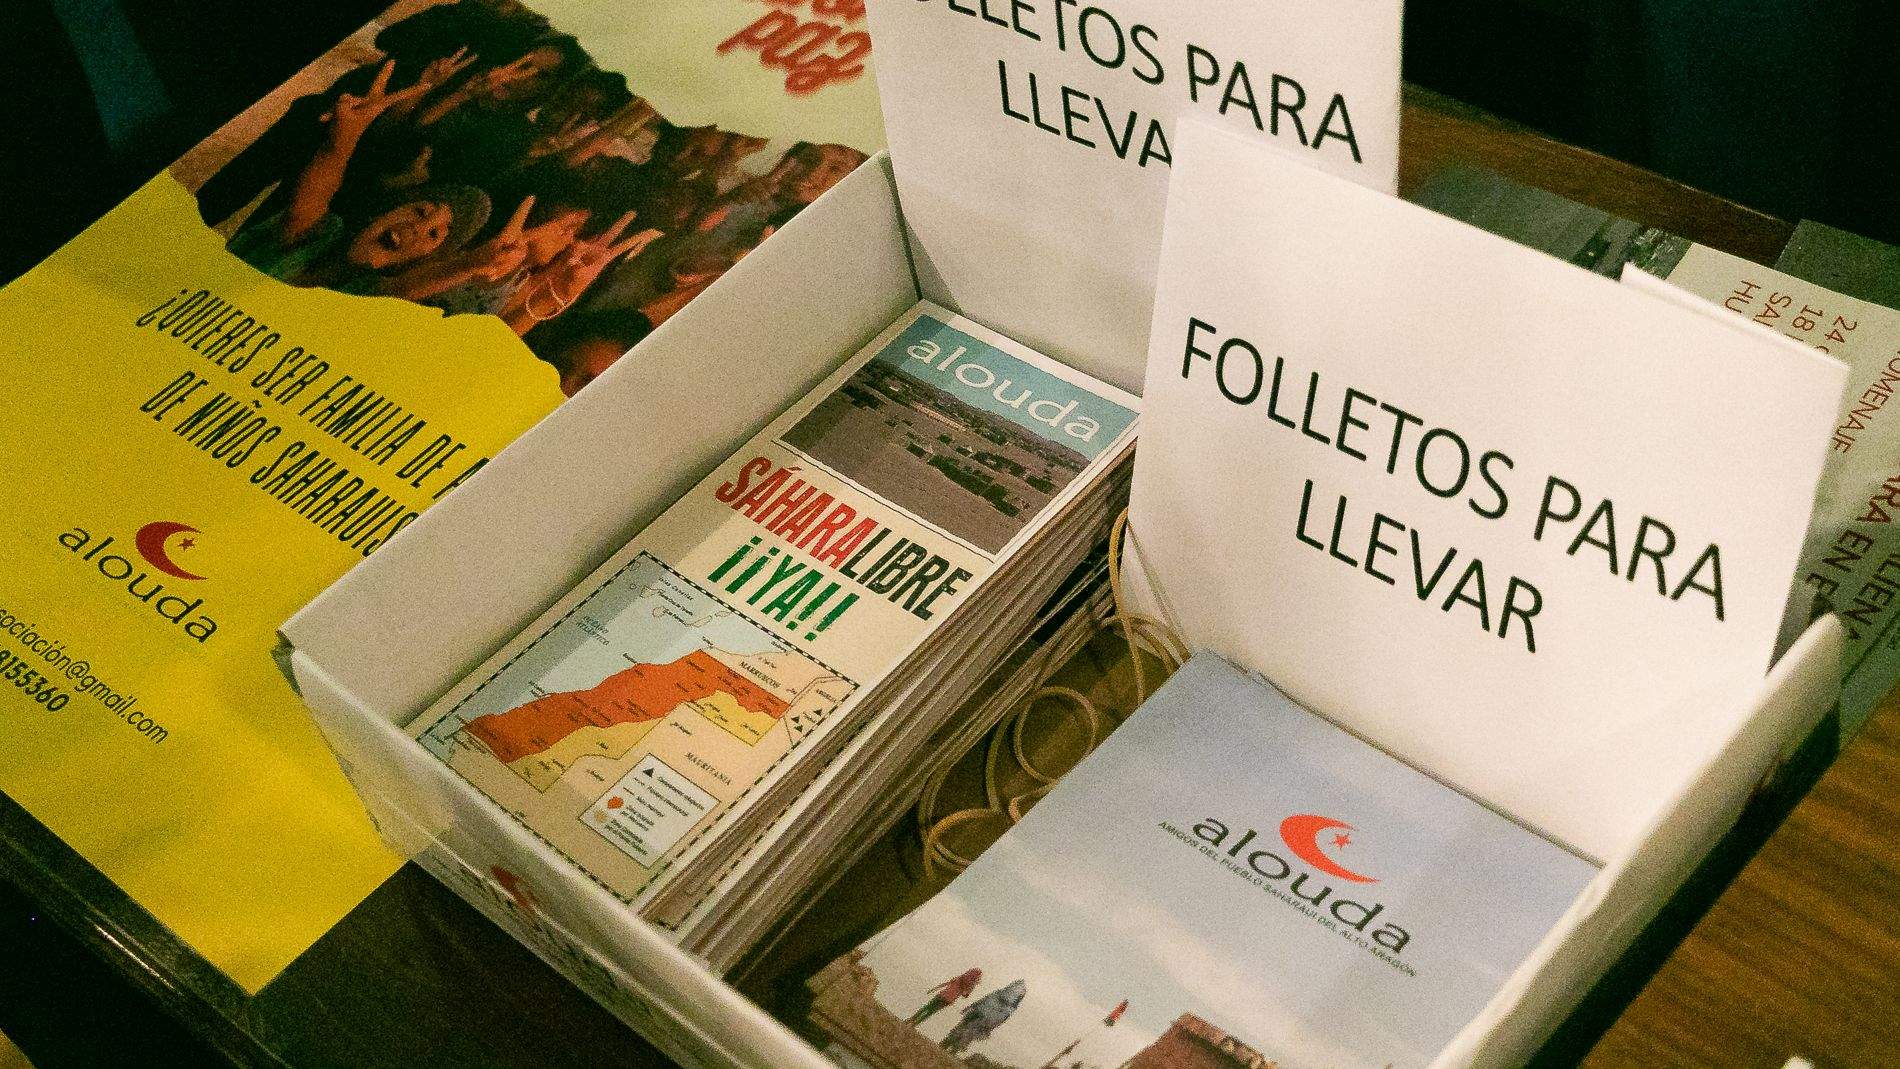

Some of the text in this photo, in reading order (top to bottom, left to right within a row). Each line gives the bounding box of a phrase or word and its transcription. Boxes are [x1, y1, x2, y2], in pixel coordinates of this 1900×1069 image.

[1186, 43, 1363, 164] PARA
[1792, 304, 1823, 332] 18
[1824, 315, 1858, 344] 24
[136, 288, 282, 374] ¿QUIERES
[250, 346, 331, 405] SER
[308, 374, 427, 467] FAMILIA
[396, 433, 467, 490] DE
[140, 370, 208, 422] DE
[173, 399, 282, 469] NIÑOS
[906, 337, 1100, 444] alouda
[1181, 316, 1726, 622] FOLLETOS PARA
[58, 526, 218, 643] alouda
[1295, 479, 1543, 654] LLEVAR
[1821, 529, 1876, 573] EN
[1158, 820, 1199, 849] AMIGOS
[1198, 844, 1219, 862] DEL
[1220, 857, 1264, 887] PUEBLO
[1316, 915, 1338, 934] DEL
[1338, 929, 1369, 950] ALTO
[1192, 816, 1411, 954] alouda
